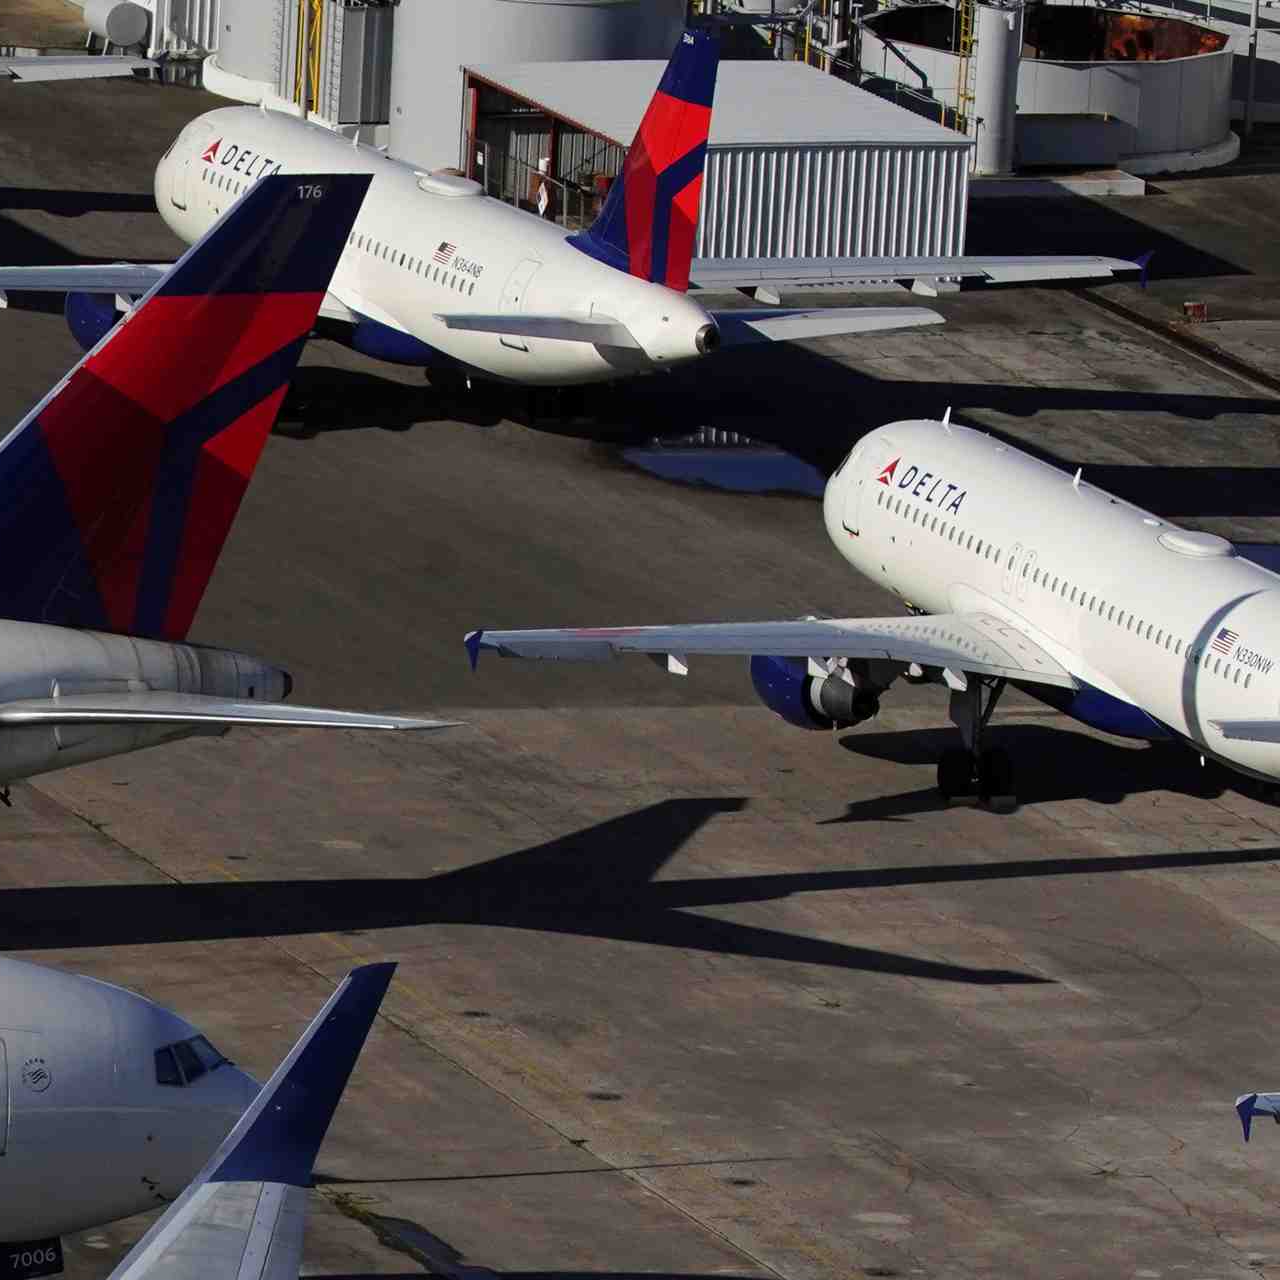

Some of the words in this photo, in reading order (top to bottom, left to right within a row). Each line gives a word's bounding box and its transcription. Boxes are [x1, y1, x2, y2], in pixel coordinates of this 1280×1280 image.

[296, 184, 322, 199] 176
[898, 465, 967, 515] DELTA
[9, 1247, 56, 1269] 7006
